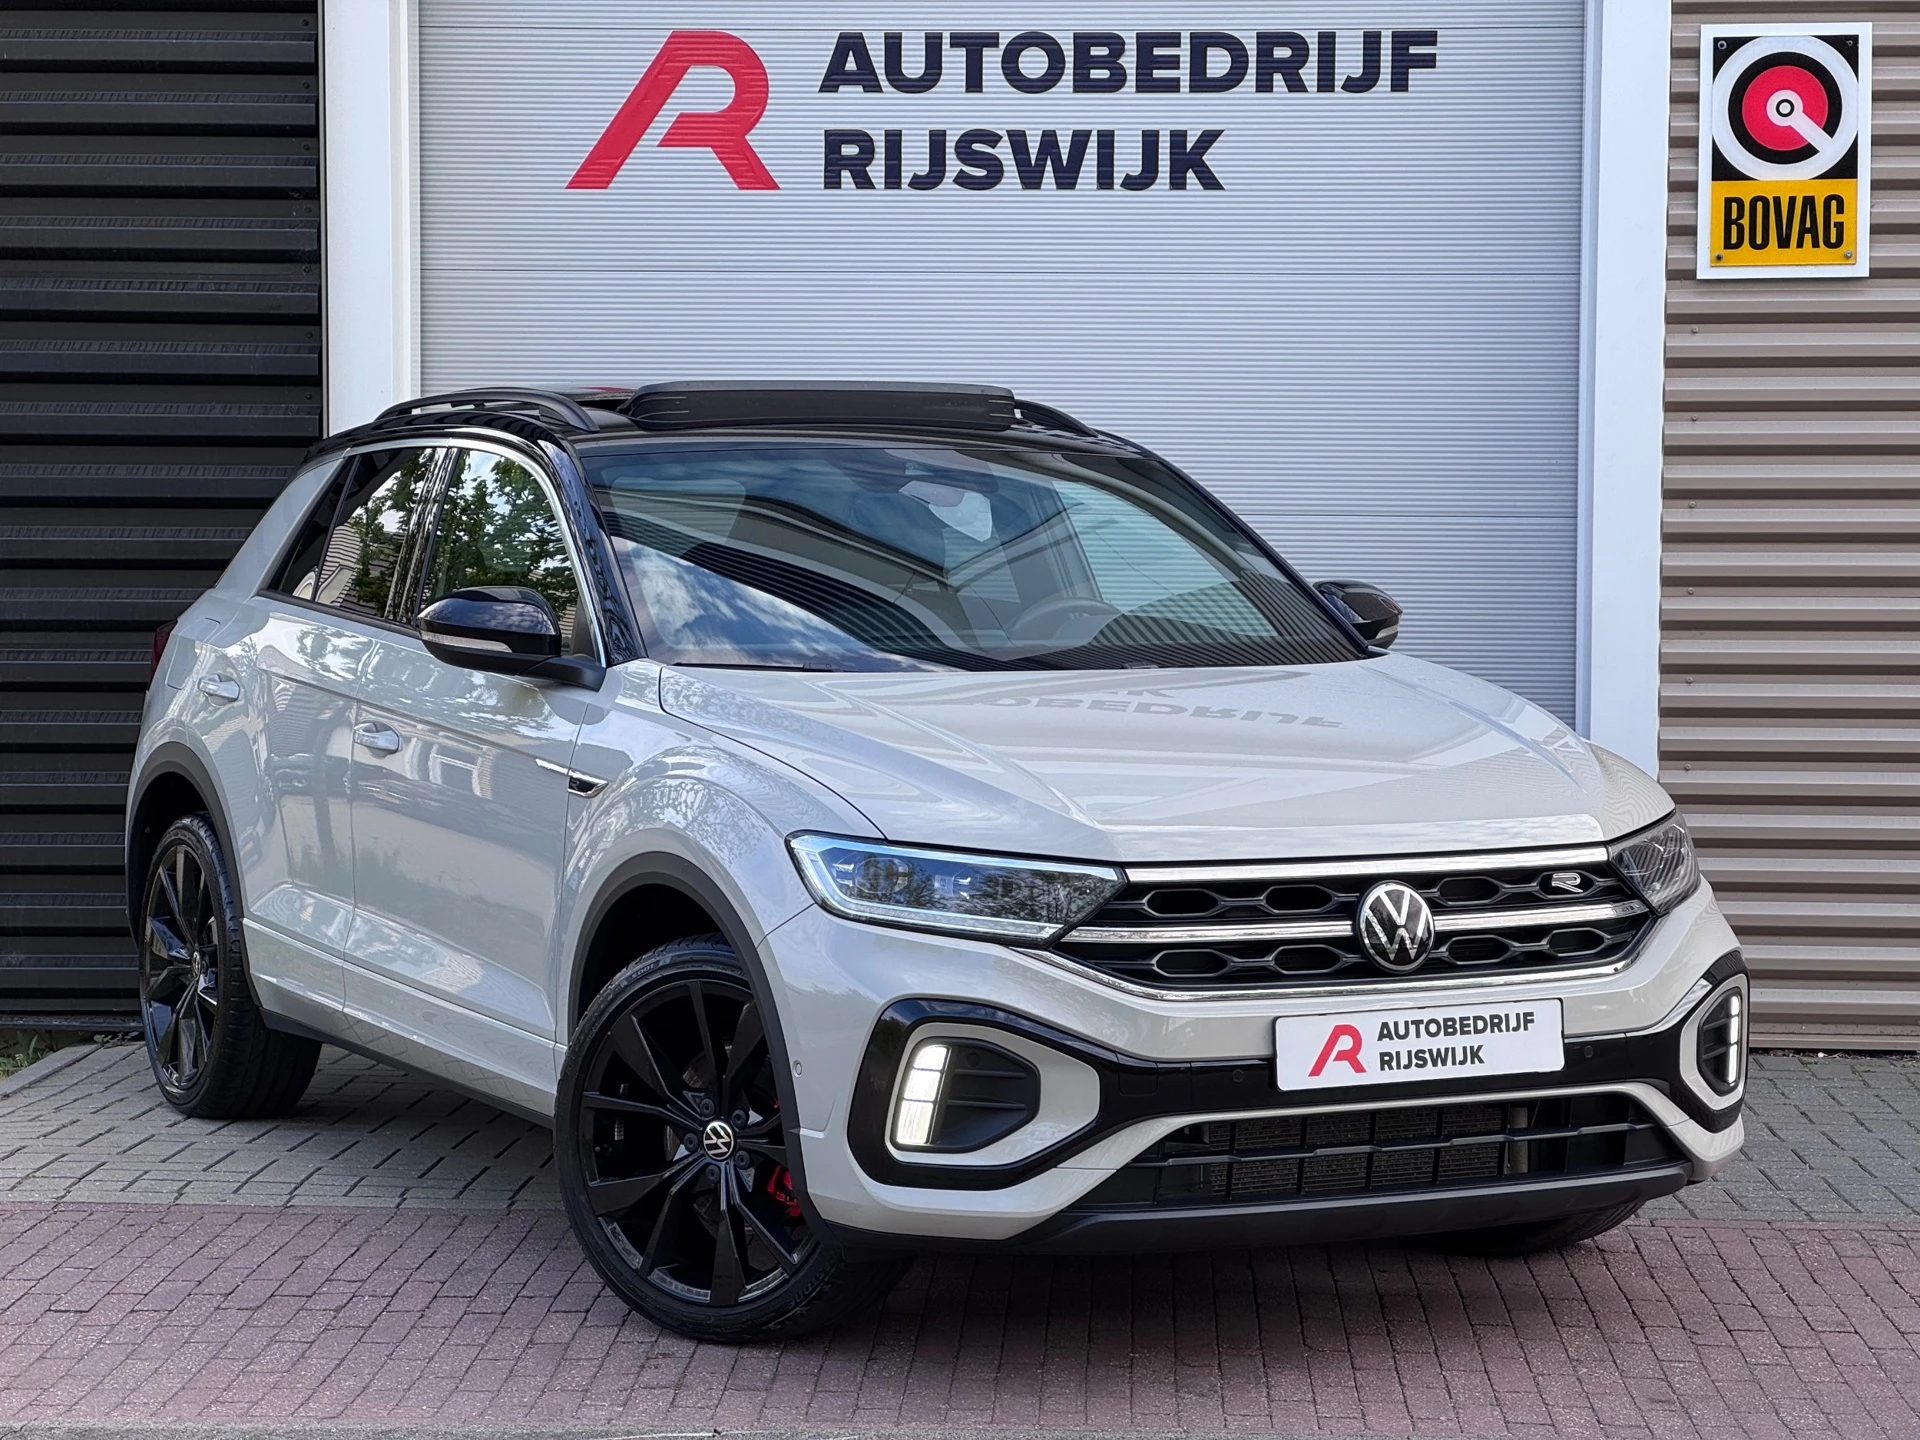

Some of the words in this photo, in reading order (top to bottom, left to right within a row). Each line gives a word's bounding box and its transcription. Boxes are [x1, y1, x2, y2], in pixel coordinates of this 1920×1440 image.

[818, 30, 1438, 94] AUTOBEDRIJF
[824, 129, 1226, 191] RIJSWIJK
[1723, 194, 1845, 250] BOVAG
[1552, 873, 1583, 892] R
[1377, 1011, 1535, 1042] AUTOBEDRIJF
[1379, 1044, 1485, 1072] RIJSWIJK
